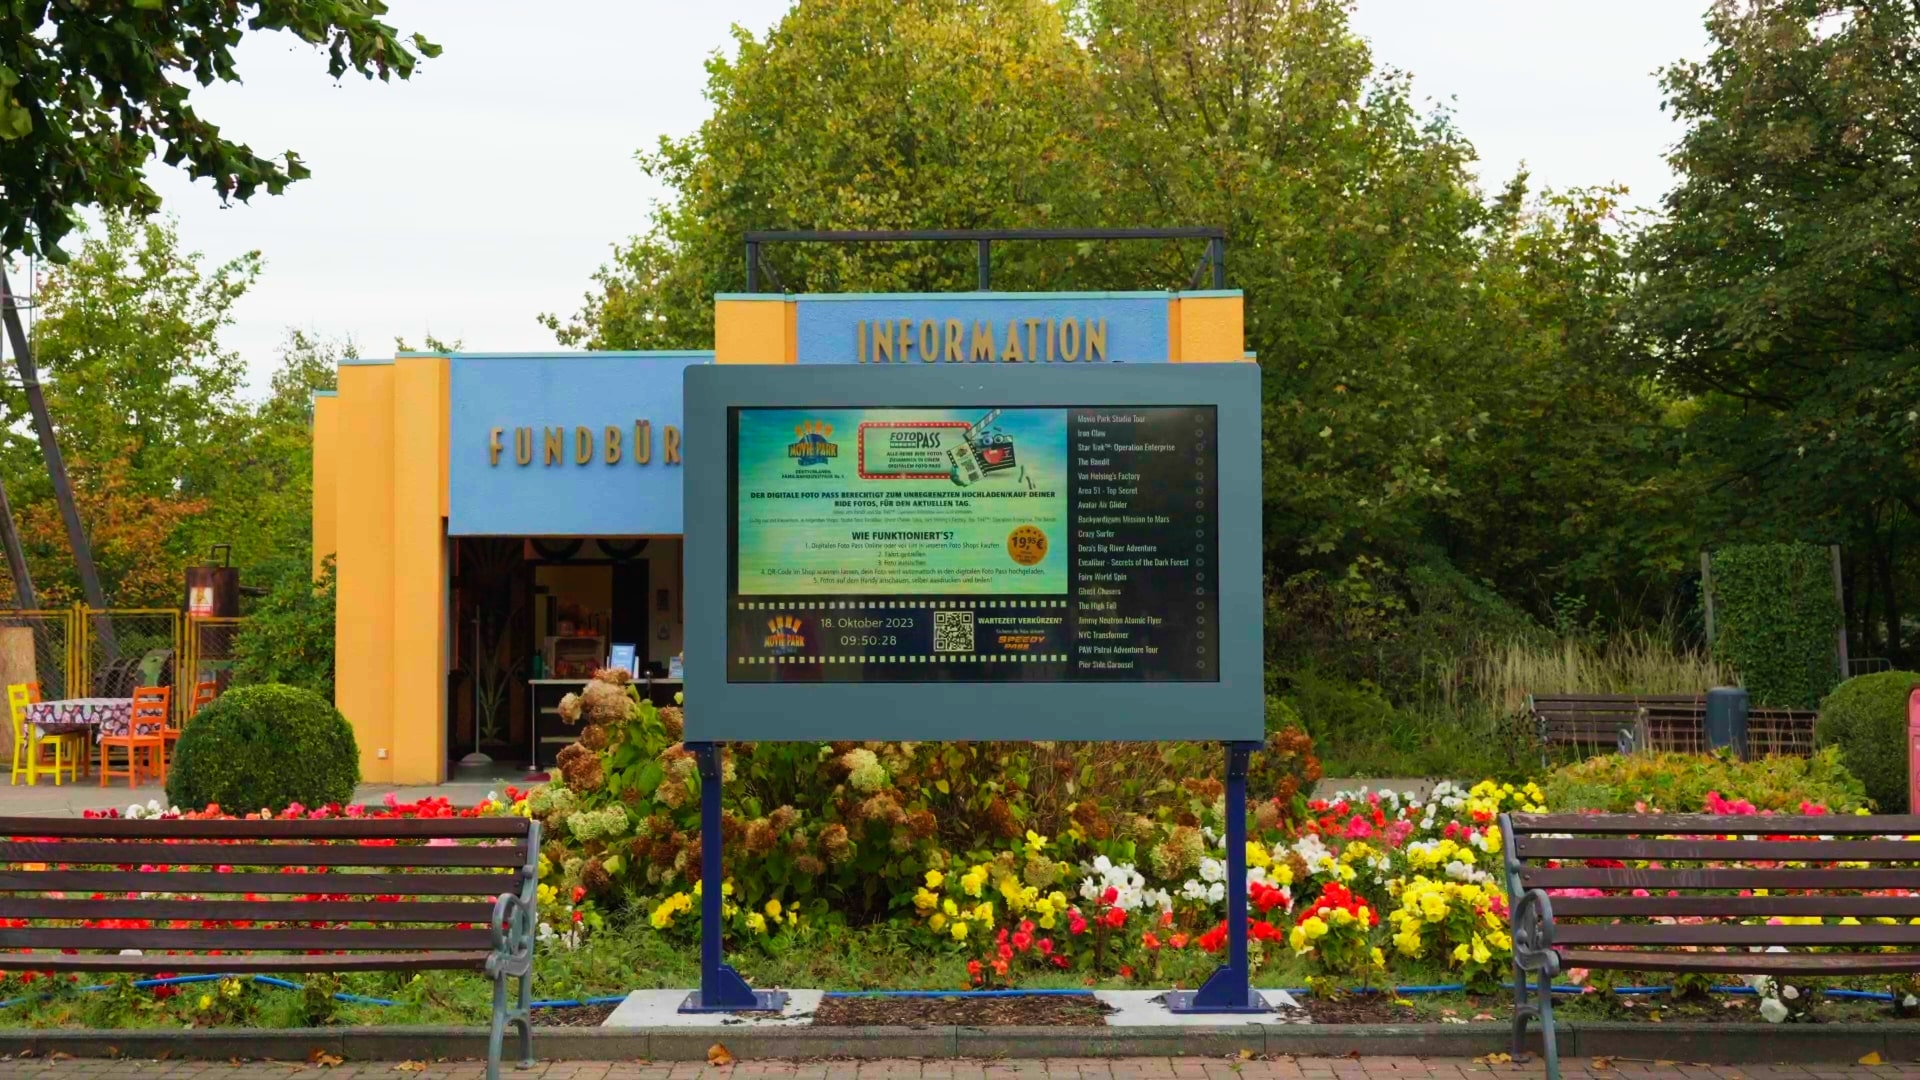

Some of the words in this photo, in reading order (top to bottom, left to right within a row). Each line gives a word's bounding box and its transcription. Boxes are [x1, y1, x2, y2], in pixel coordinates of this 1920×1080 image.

[857, 318, 1107, 362] INFORMATION
[1114, 444, 1144, 452] Operation
[1144, 444, 1176, 452] Enterprise
[1090, 473, 1117, 481] Helsing's
[1118, 473, 1140, 481] Factory
[1106, 488, 1117, 496] Top
[880, 499, 894, 507] FÜR
[852, 532, 870, 540] WIE
[872, 532, 954, 540] FUNKTIONIERT'S?
[1078, 530, 1094, 539] Crazy
[1097, 544, 1108, 553] Big
[1078, 573, 1093, 582] Fairy
[1114, 573, 1127, 582] Spin
[1090, 602, 1104, 610] High
[820, 618, 834, 628] 18.
[838, 618, 884, 628] Oktober
[885, 618, 914, 628] 2023
[1018, 616, 1062, 624] VERKÜRZEN?
[1078, 616, 1098, 625] Jimmy
[1147, 616, 1162, 625] Flyer
[786, 634, 805, 647] PARK
[840, 636, 897, 646] 09:50:28
[998, 636, 1046, 644] SPEEDY
